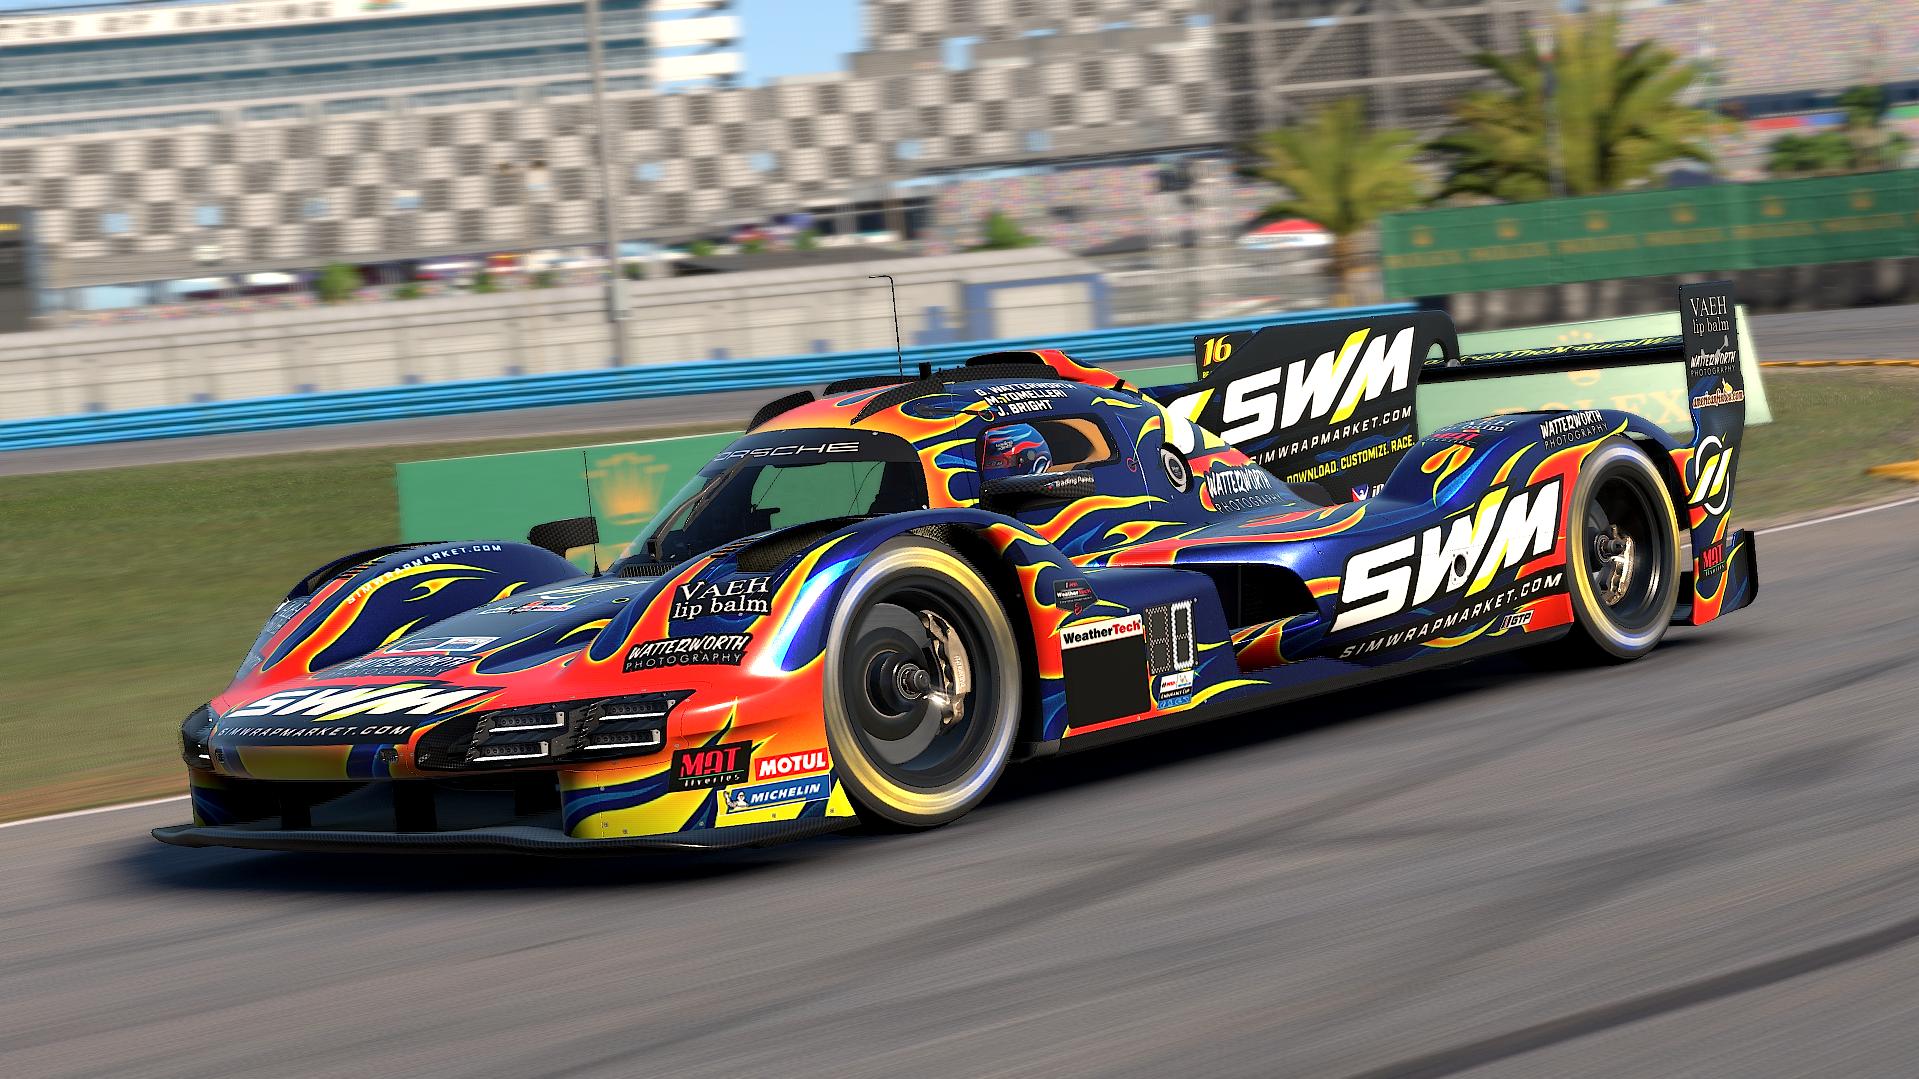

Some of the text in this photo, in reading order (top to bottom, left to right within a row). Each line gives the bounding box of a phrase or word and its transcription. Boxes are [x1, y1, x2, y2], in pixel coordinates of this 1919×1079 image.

[1690, 296, 1727, 316] VAEH
[1692, 317, 1729, 336] lip balm
[1203, 334, 1231, 366] 16
[1691, 351, 1736, 368] WATTERWORTH
[1691, 365, 1736, 377] PHOTOGRAPHY
[1220, 327, 1415, 446] SWM
[1008, 400, 1053, 414] BRIGHT
[1540, 410, 1602, 440] WATTERWORTH
[1544, 423, 1609, 449] PHOTOGRAPHY
[713, 442, 860, 462] ORSCHE
[1341, 444, 1390, 470] CUSTOMIZE.
[1391, 435, 1415, 453] RACE.
[1330, 480, 1560, 633] SWM
[1703, 544, 1722, 569] MAT
[348, 545, 502, 605] SIMWRAPMARKET.COM
[680, 577, 771, 600] VAEH
[673, 595, 768, 619] lip balm
[1339, 573, 1563, 658] SIMWRAPMARKET.COM
[1064, 620, 1141, 644] WeatherTech
[629, 635, 749, 660] WATTERWORTH
[626, 653, 742, 670] PHOTOGRAPHY
[226, 683, 489, 722] SWM
[218, 725, 412, 738] SIMWRAPMARKET.COM
[680, 747, 741, 778] MAT
[759, 752, 826, 776] MOTUL
[684, 774, 741, 788] liveries
[751, 784, 821, 804] MICHELIN
